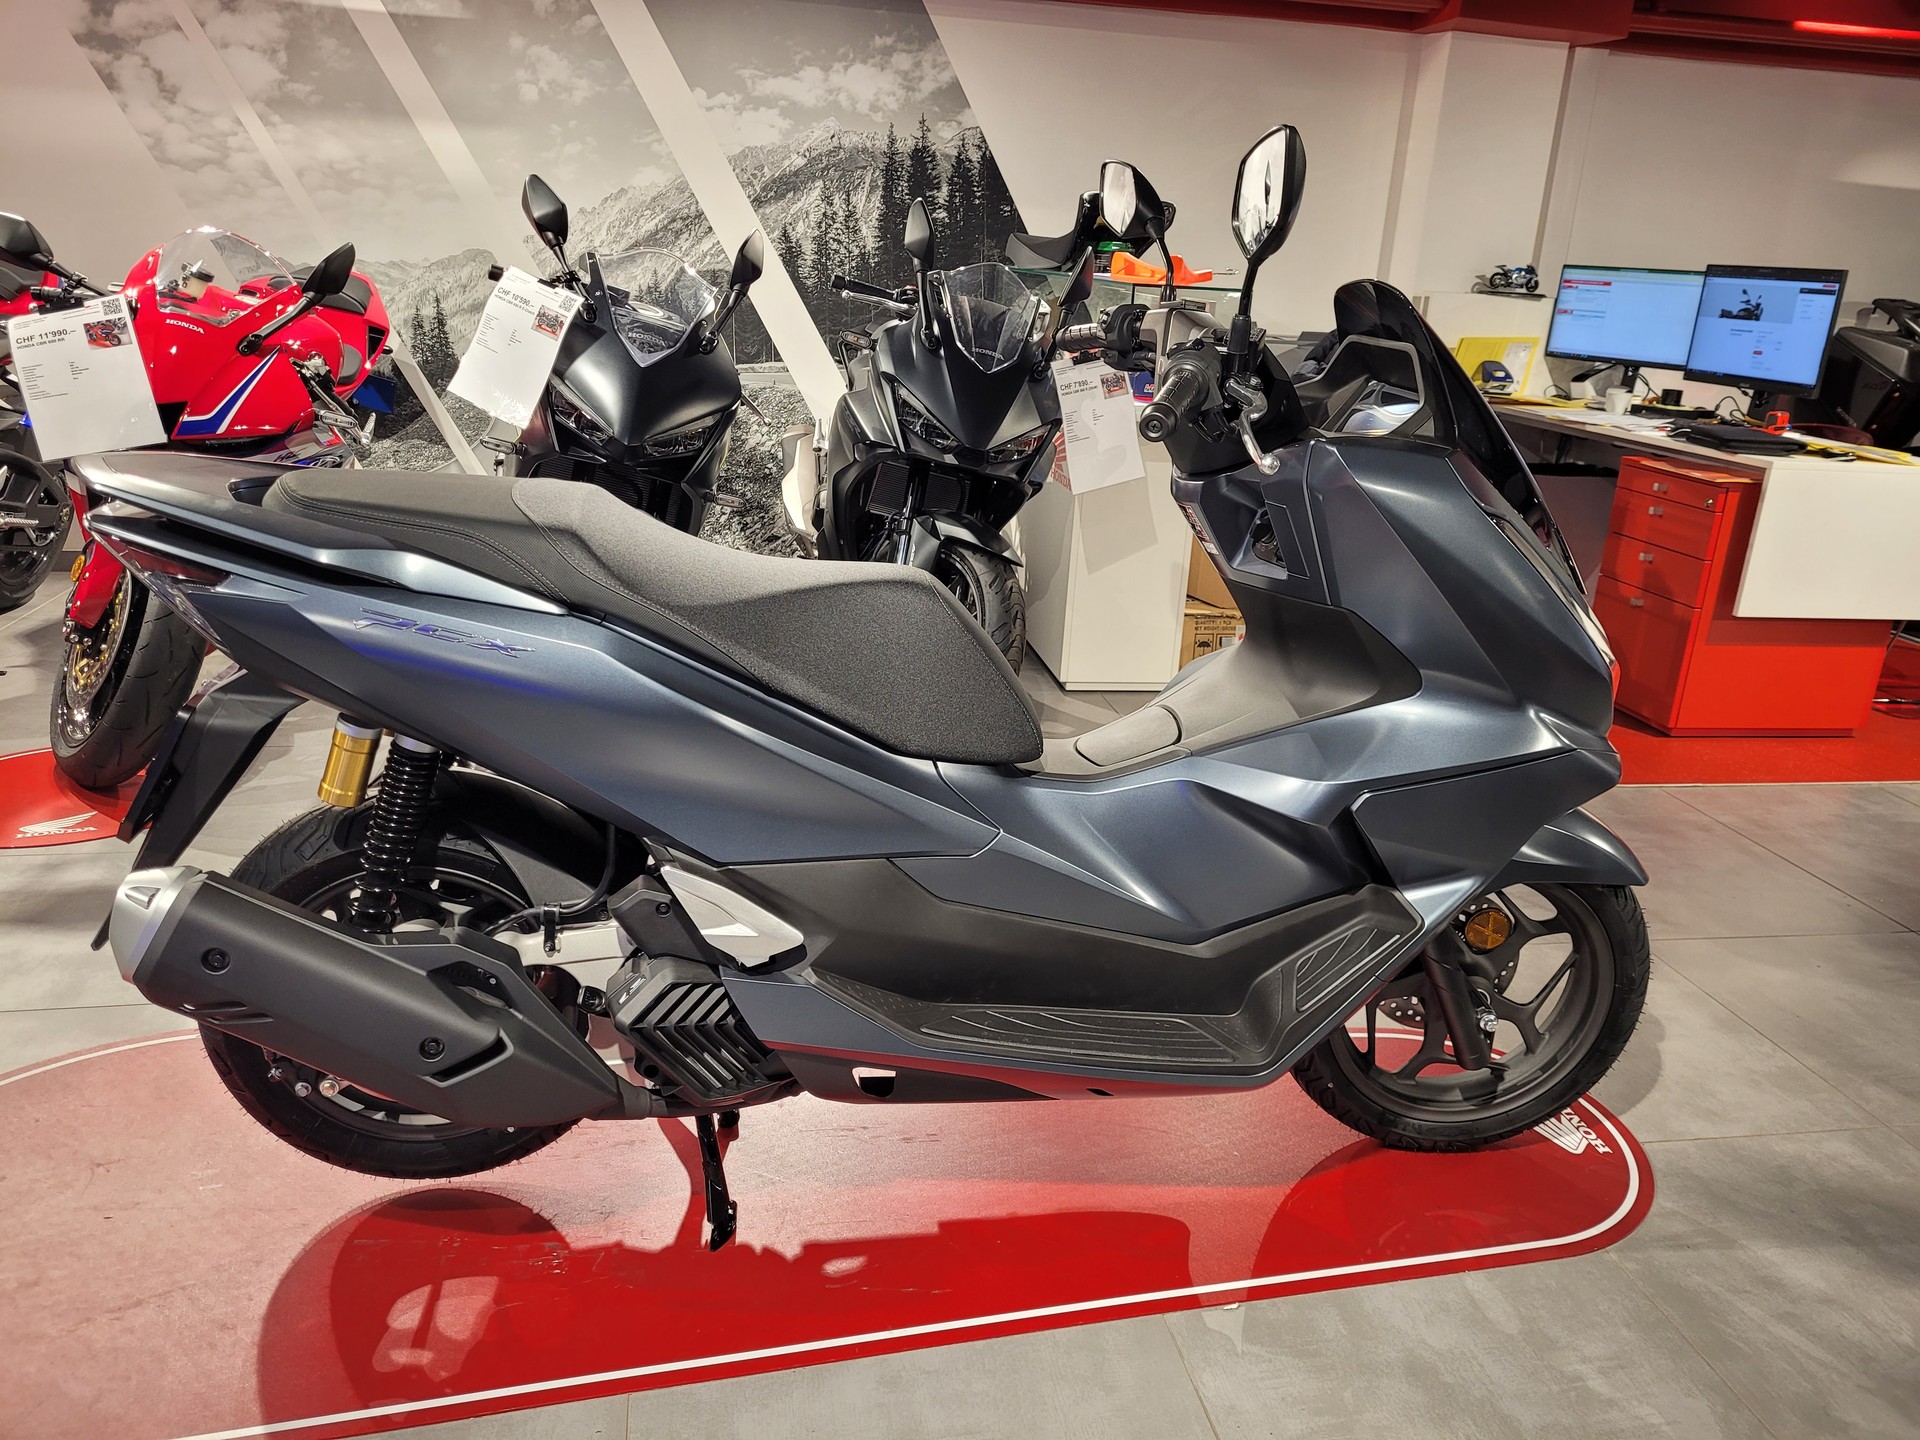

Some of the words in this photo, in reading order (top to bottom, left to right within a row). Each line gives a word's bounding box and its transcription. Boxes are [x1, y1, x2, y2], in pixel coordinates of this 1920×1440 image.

[497, 287, 511, 297] CHF
[165, 318, 205, 334] HONDA
[15, 334, 36, 345] CHF
[627, 332, 668, 347] HONDA
[972, 347, 1005, 360] HONDA
[353, 607, 536, 658] PCX
[15, 826, 98, 839] HONDA
[1560, 1107, 1613, 1154] HON
